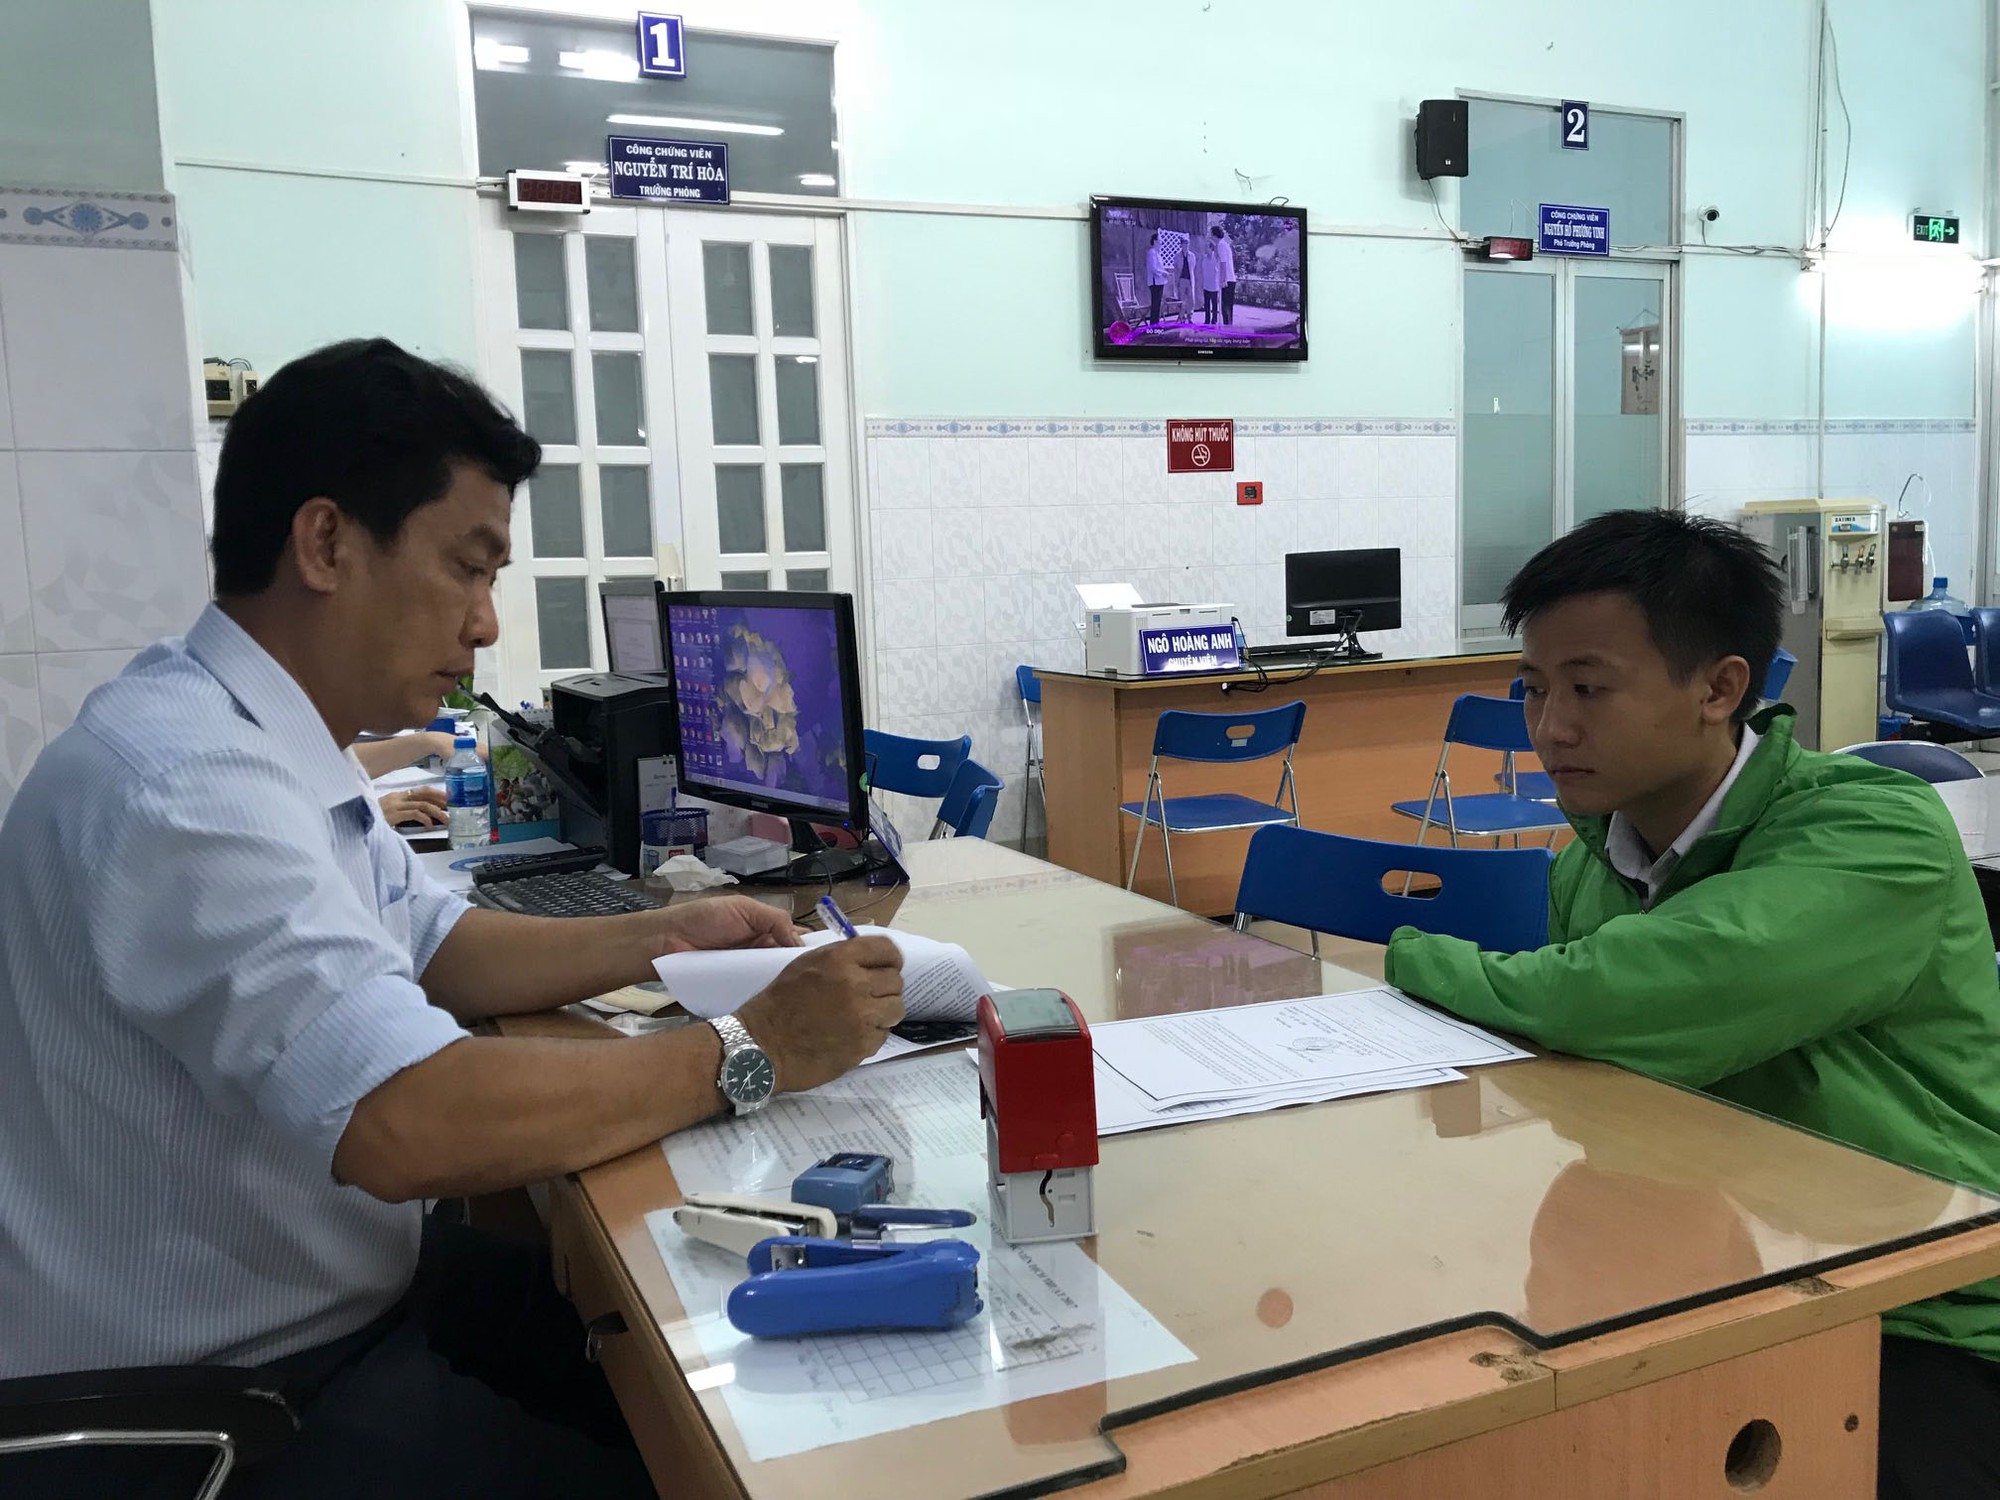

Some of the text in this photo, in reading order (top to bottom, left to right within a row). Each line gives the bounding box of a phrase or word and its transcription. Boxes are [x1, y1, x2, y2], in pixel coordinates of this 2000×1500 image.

[650, 22, 676, 67] 1
[1566, 108, 1585, 143] 2
[626, 143, 712, 159] CÔNG CHỨNG VIÊN
[614, 157, 725, 181] NGUYỄN TRÍ HÒA
[639, 183, 701, 198] TRƯỞNG PHÒNG
[1550, 210, 1566, 220] CÔNG
[1586, 213, 1599, 222] VIÊN
[1916, 224, 1929, 236] EXIT
[1171, 423, 1229, 443] KHÔNG HÚT THUỐC
[1147, 631, 1233, 654] NGÔ HOÀNG ANH
